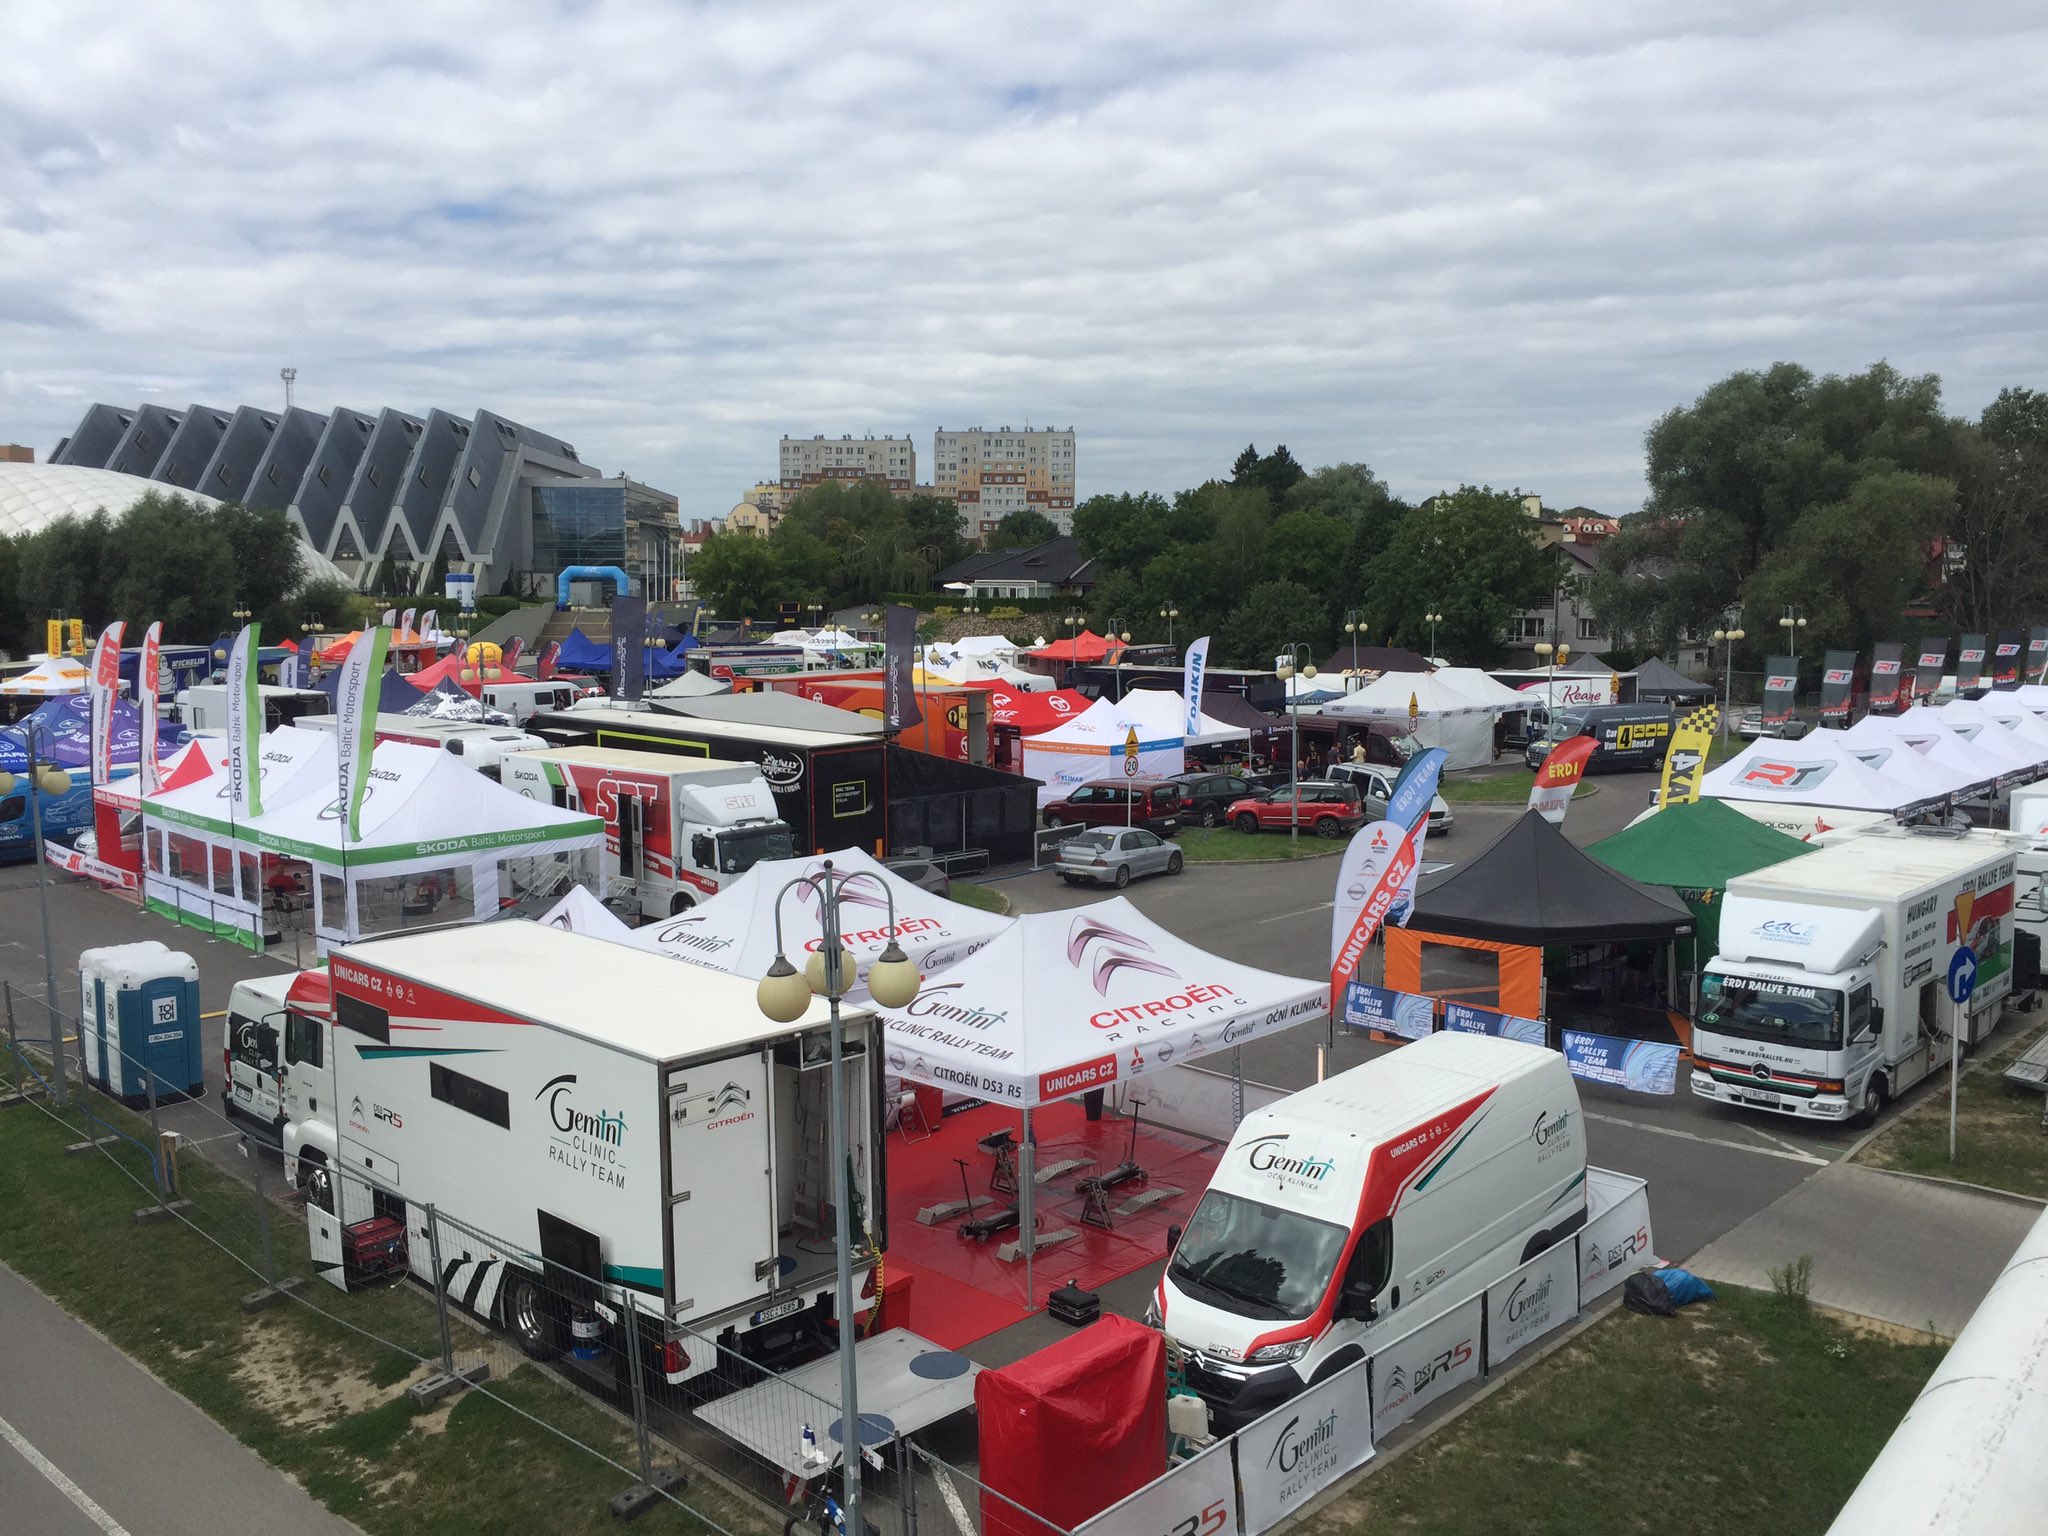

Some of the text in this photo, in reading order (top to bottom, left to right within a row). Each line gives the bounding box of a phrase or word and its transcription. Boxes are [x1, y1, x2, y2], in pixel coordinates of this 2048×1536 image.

[1962, 651, 1983, 660] RT
[1999, 645, 2017, 654] RT
[2031, 641, 2046, 650] RT
[171, 657, 206, 669] MICHELIN
[617, 636, 627, 697] Motorsport
[1876, 662, 1898, 671] RT
[1921, 655, 1942, 664] RT
[764, 666, 790, 674] EDGE
[1827, 671, 1850, 681] RT
[890, 654, 899, 727] Motorsport
[1190, 652, 1203, 719] DAIKIN
[1769, 677, 1793, 688] RT
[1562, 685, 1602, 705] Keane
[232, 655, 242, 803] ŠKODA Baltic Motorsport
[1605, 727, 1631, 748] Car 4
[339, 660, 362, 825] ŠKODA Baltic Motorsport
[1603, 741, 1617, 751] Van
[262, 752, 293, 764] ŠKODA
[771, 758, 800, 770] RALLY
[1127, 758, 1137, 771] 20
[514, 770, 540, 783] ŠKODA
[1061, 775, 1084, 783] KLIMAR
[1414, 759, 1437, 789] TEAM
[1548, 762, 1579, 779] ÉRDI
[1743, 762, 1825, 786] RT
[723, 794, 757, 810] SRT
[257, 832, 280, 847] ŠKODA
[416, 829, 547, 856] ŠKODA Baltic Motorsport
[1977, 860, 2015, 892] RALLYE TEAM
[1337, 889, 1391, 975] UNICARS
[1386, 859, 1410, 888] CZ
[1906, 894, 1939, 925] HUNGARY
[333, 963, 382, 993] UNICARS CZ
[1756, 973, 1785, 981] HUNGARY
[1356, 984, 1372, 996] ÉRDI
[1722, 976, 1816, 999] ÉRDI RALLYE TEAM
[158, 999, 175, 1012] TOI
[906, 990, 1009, 1031] Gemini
[1266, 996, 1323, 1026] OČNÍ KLINIKA
[1358, 996, 1383, 1008] RALLYE
[1364, 1005, 1383, 1017] TEAM
[158, 1012, 175, 1021] TOI
[1104, 997, 1250, 1043] RACING
[1456, 1006, 1473, 1020] ÉRDI
[1459, 1018, 1486, 1031] RALLYE
[889, 1019, 1015, 1061] CLINIC RALLY TEAM
[1574, 1034, 1596, 1047] ÉRDI
[1576, 1045, 1609, 1058] RALLYE
[1583, 1055, 1608, 1067] TEAM
[933, 1066, 1022, 1099] CITROËN DS3 R5
[1045, 1062, 1115, 1094] UNICARS CZ
[383, 1107, 403, 1129] R5
[549, 1086, 629, 1148] Gemini
[706, 1112, 755, 1130] CITROËN
[572, 1135, 616, 1165] CLINIC
[1389, 1134, 1428, 1159] UNICARS CZ
[1537, 1139, 1571, 1165] RALLY TEAM
[549, 1145, 626, 1190] RALLY TEAM
[1249, 1142, 1336, 1181] Gemini
[1286, 1175, 1319, 1192] KLINIKA
[1607, 1244, 1623, 1264] DS3
[1622, 1225, 1648, 1263] R5
[1520, 1304, 1546, 1324] CLINIC
[1505, 1311, 1551, 1347] RALLY TEAM
[1218, 1344, 1242, 1359] R5
[1414, 1362, 1432, 1387] DS3
[1431, 1338, 1473, 1382] R5
[1278, 1408, 1339, 1474] Gemini
[1297, 1443, 1331, 1473] CLINIC
[1280, 1454, 1338, 1504] RALLY TEAM
